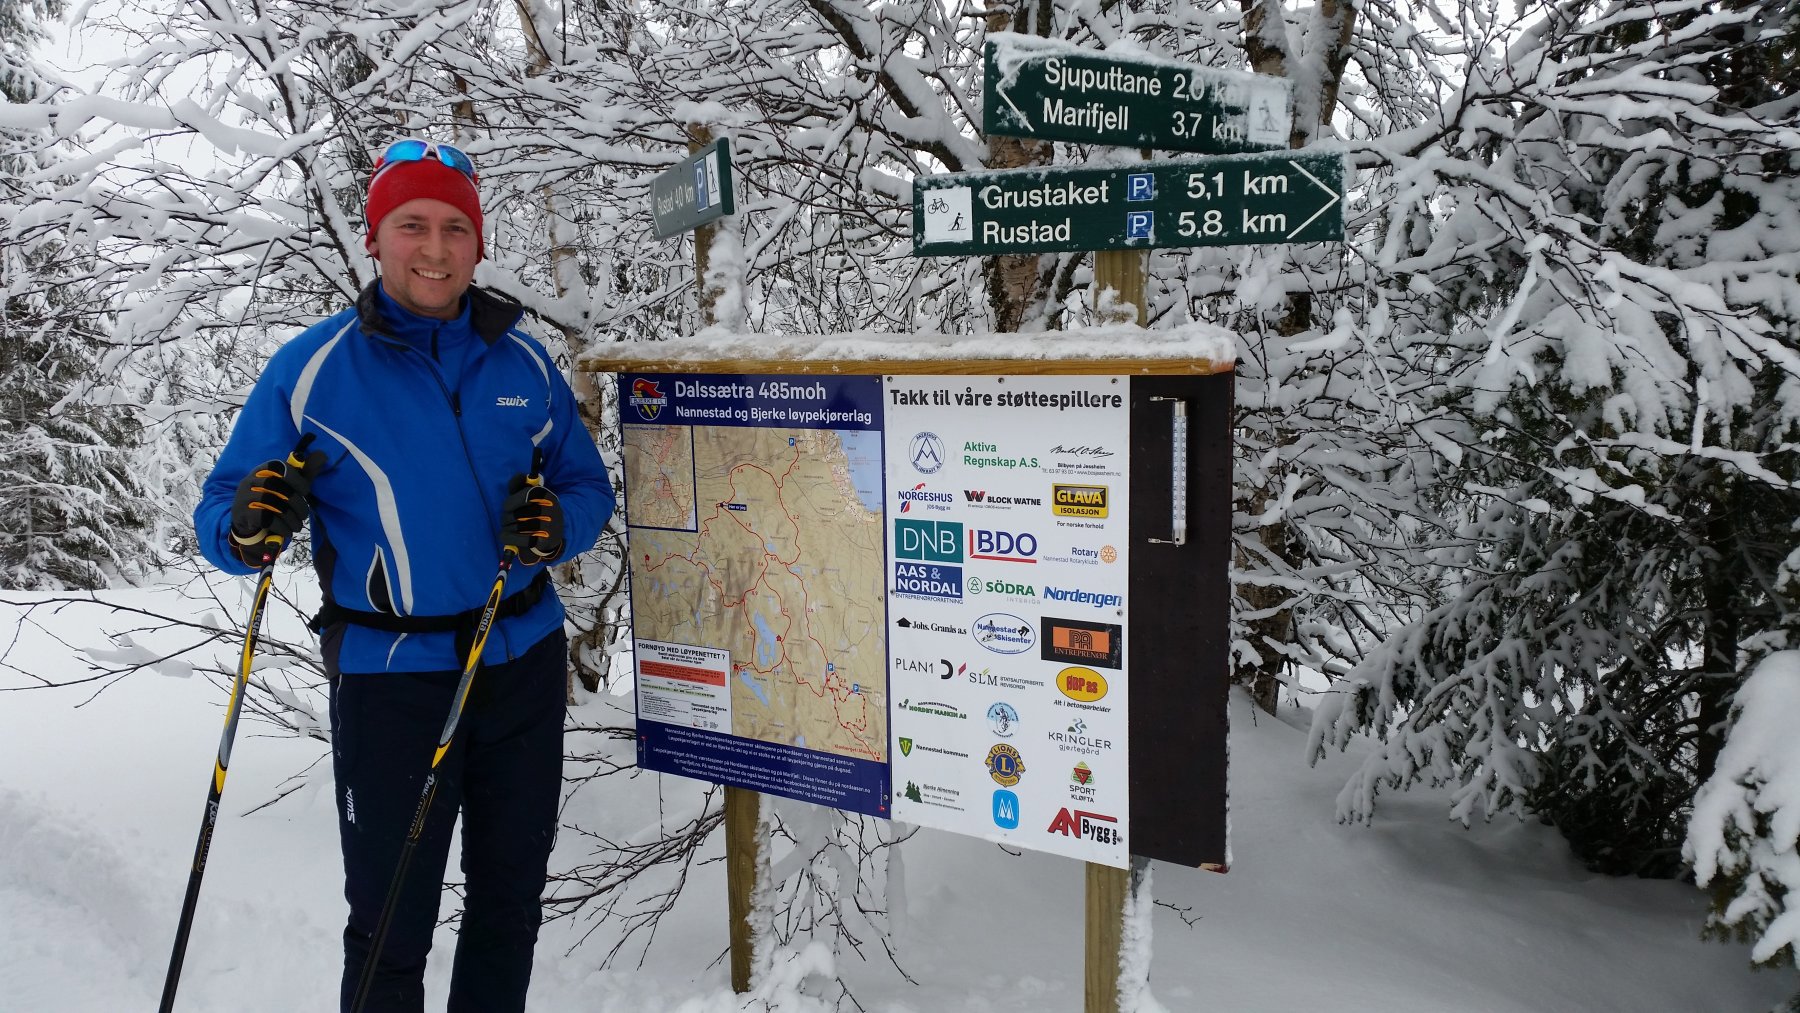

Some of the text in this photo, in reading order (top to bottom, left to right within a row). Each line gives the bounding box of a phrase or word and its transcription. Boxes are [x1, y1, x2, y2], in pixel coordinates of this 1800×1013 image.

[1044, 57, 1162, 97] Sjuputtane
[1172, 73, 1205, 102] 2,0
[1043, 97, 1129, 132] Marifjell
[1171, 110, 1202, 139] 3,7
[982, 179, 1110, 210] Grustaket
[1187, 172, 1224, 203] 5,1
[1243, 170, 1288, 196] km
[983, 217, 1071, 245] Rustad
[1178, 210, 1223, 238] 5,8
[1242, 208, 1287, 234] km
[675, 380, 827, 401] Dalssætra 485moh
[890, 386, 1122, 411] Takk til våre støttespillere
[675, 405, 872, 425] Nannestad og Bjerke løypekjørerlag
[963, 441, 997, 453] Aktiva
[963, 455, 1041, 469] Regnskap A.S.
[898, 490, 953, 503] NORGESHUS
[987, 496, 1012, 504] BLOCK
[1013, 497, 1042, 506] WATNE
[1056, 489, 1104, 505] GLAVA
[1060, 507, 1100, 516] ISOLASJON
[903, 524, 956, 557] DNB
[977, 529, 1038, 557] BDO
[1071, 546, 1099, 559] Rotary
[896, 564, 941, 580] AAS &
[897, 577, 961, 596] NORDAL
[985, 579, 1036, 597] SÖDRA
[1043, 585, 1122, 608] Nordengen
[996, 634, 1032, 645] Skisenter
[638, 642, 666, 652] FORNØYD
[667, 646, 680, 654] MED
[1054, 647, 1109, 660] ENTREPRENØR
[895, 657, 934, 674] PLAN1
[969, 671, 998, 687] SLM
[1086, 680, 1098, 694] as
[915, 743, 943, 754] Nannestad
[1048, 731, 1112, 750] KRINGLER
[993, 745, 1017, 757] LIONS
[1001, 757, 1011, 773] L
[1069, 784, 1097, 796] SPORT
[1070, 794, 1095, 804] KLØFTA
[1082, 817, 1110, 844] Bygg
